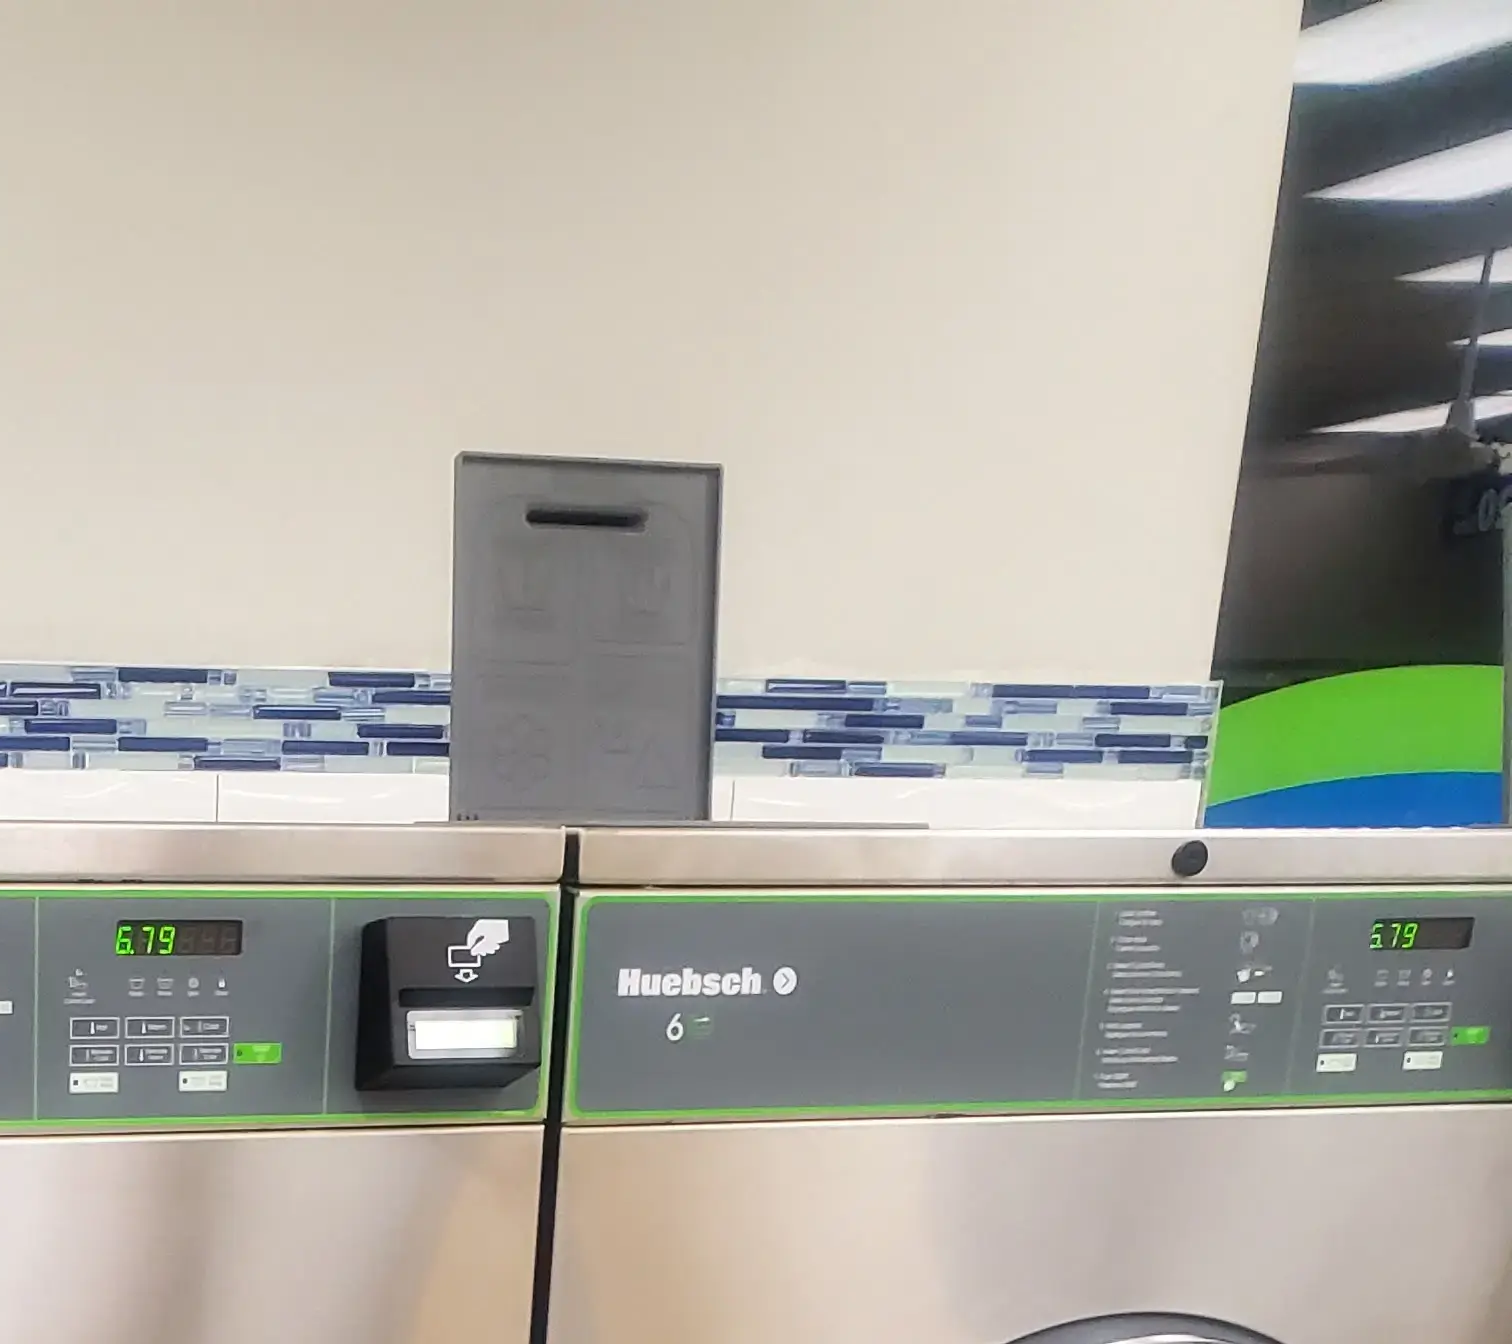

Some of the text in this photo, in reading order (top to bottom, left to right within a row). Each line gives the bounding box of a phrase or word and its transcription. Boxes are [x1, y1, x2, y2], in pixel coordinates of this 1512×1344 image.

[115, 926, 176, 955] 6.79
[617, 966, 762, 997] Huebsch
[664, 1012, 685, 1041] 6
